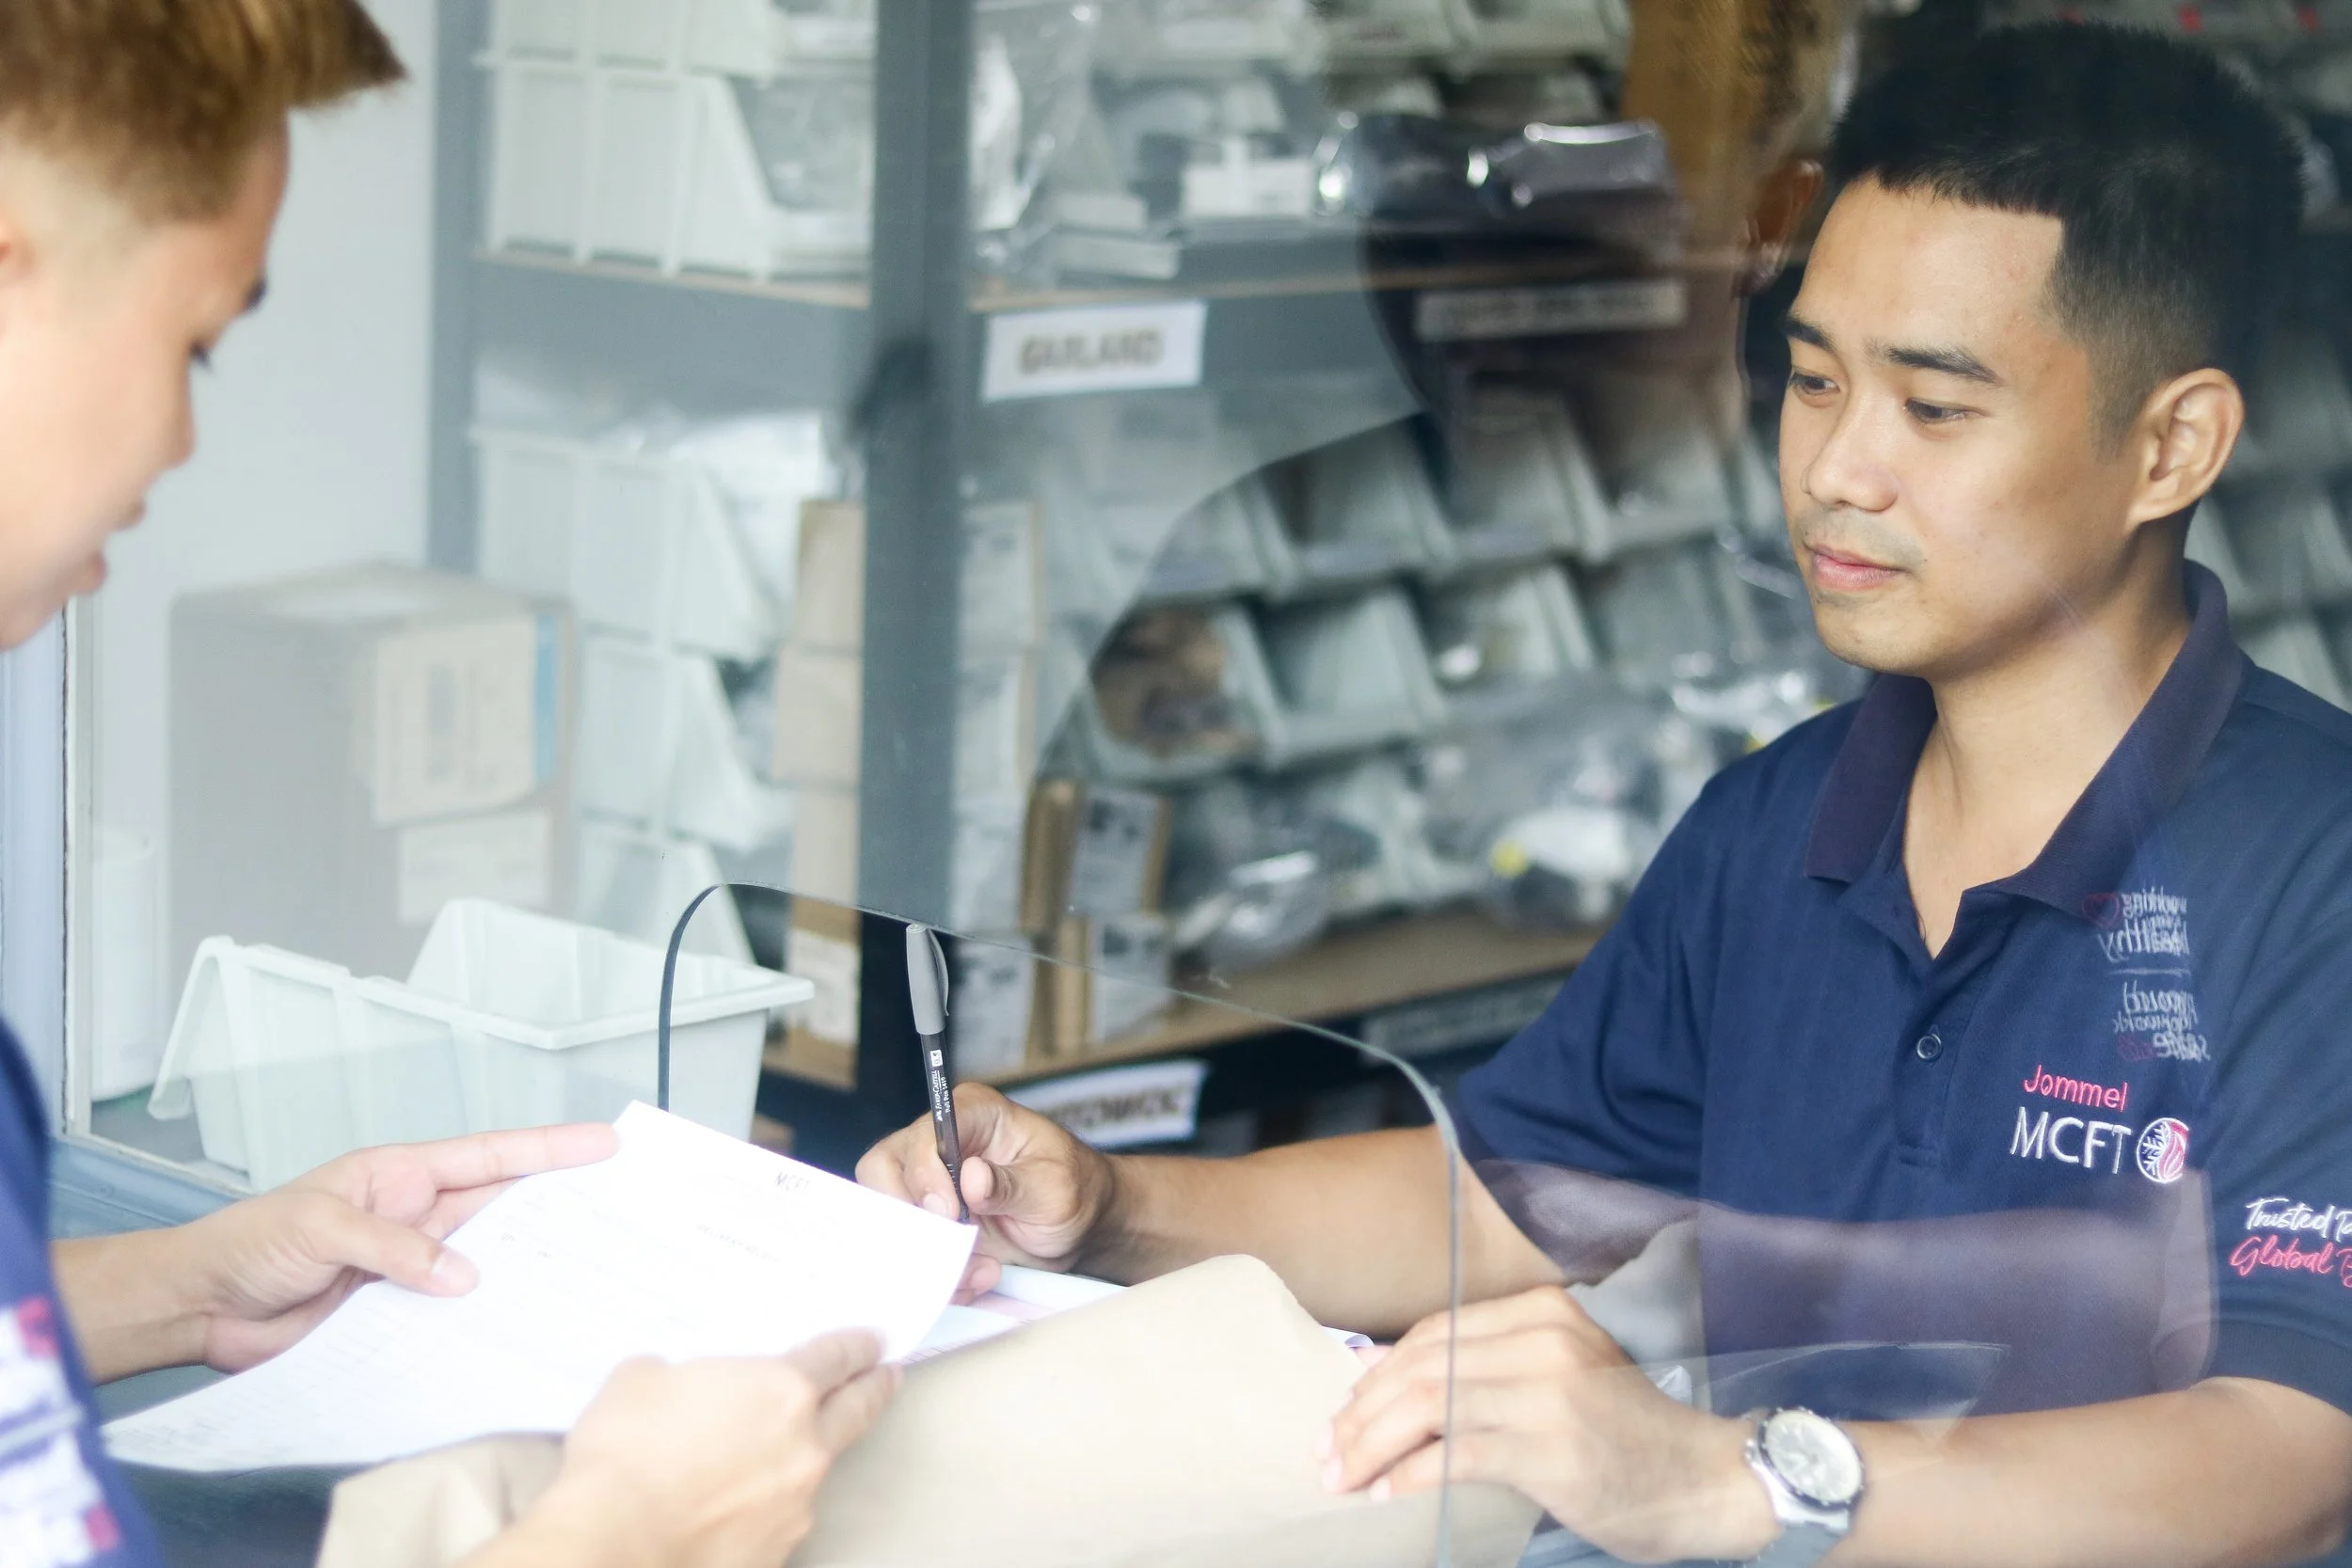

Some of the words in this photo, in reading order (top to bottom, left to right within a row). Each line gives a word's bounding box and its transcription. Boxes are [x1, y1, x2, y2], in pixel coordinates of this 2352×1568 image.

[2024, 1064, 2128, 1112] Jommel
[2009, 1106, 2132, 1174] MCFT
[2245, 1196, 2335, 1239] Trusted
[2228, 1234, 2335, 1277] Global
